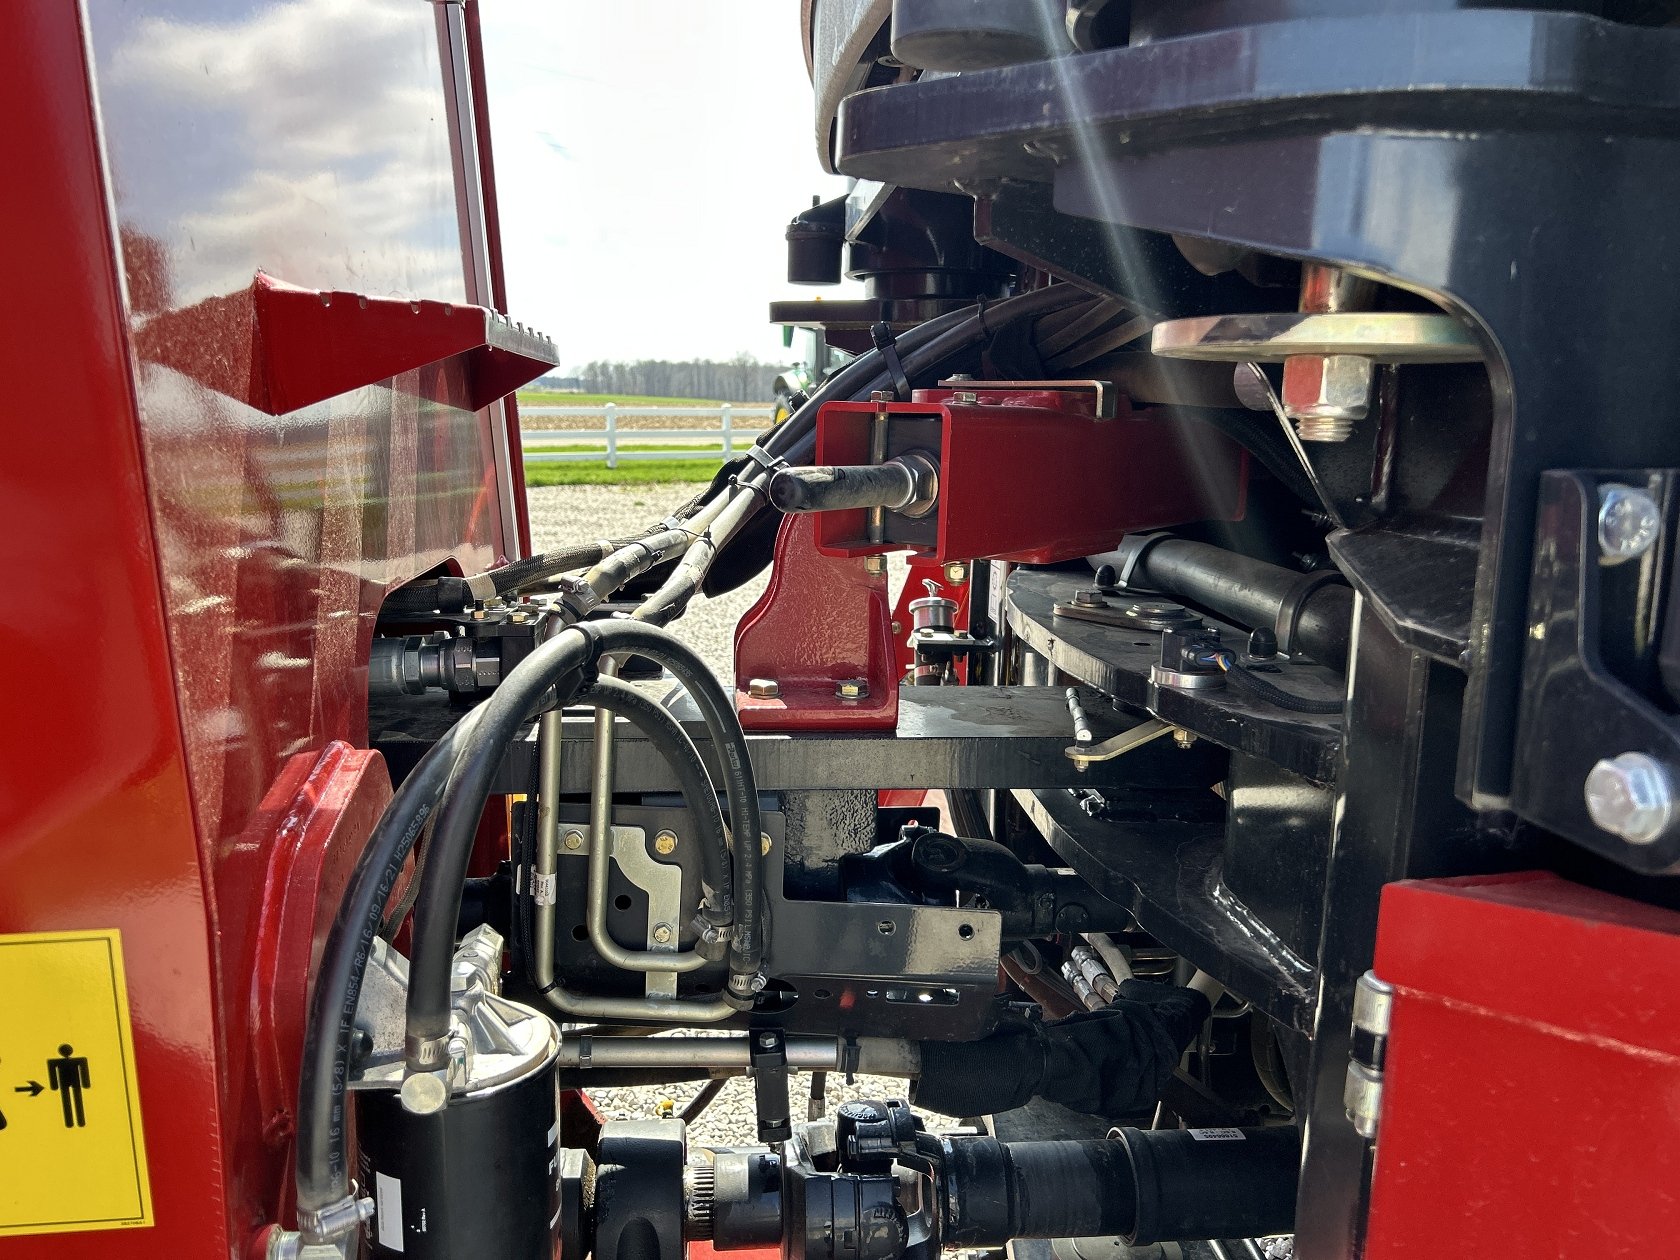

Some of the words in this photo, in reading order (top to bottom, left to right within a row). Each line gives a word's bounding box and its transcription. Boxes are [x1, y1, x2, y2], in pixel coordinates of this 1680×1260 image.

[394, 803, 430, 861] H25065896
[335, 1043, 347, 1052] X
[331, 1058, 345, 1096] (5/8)
[332, 1104, 341, 1122] mm
[328, 1126, 340, 1144] 16
